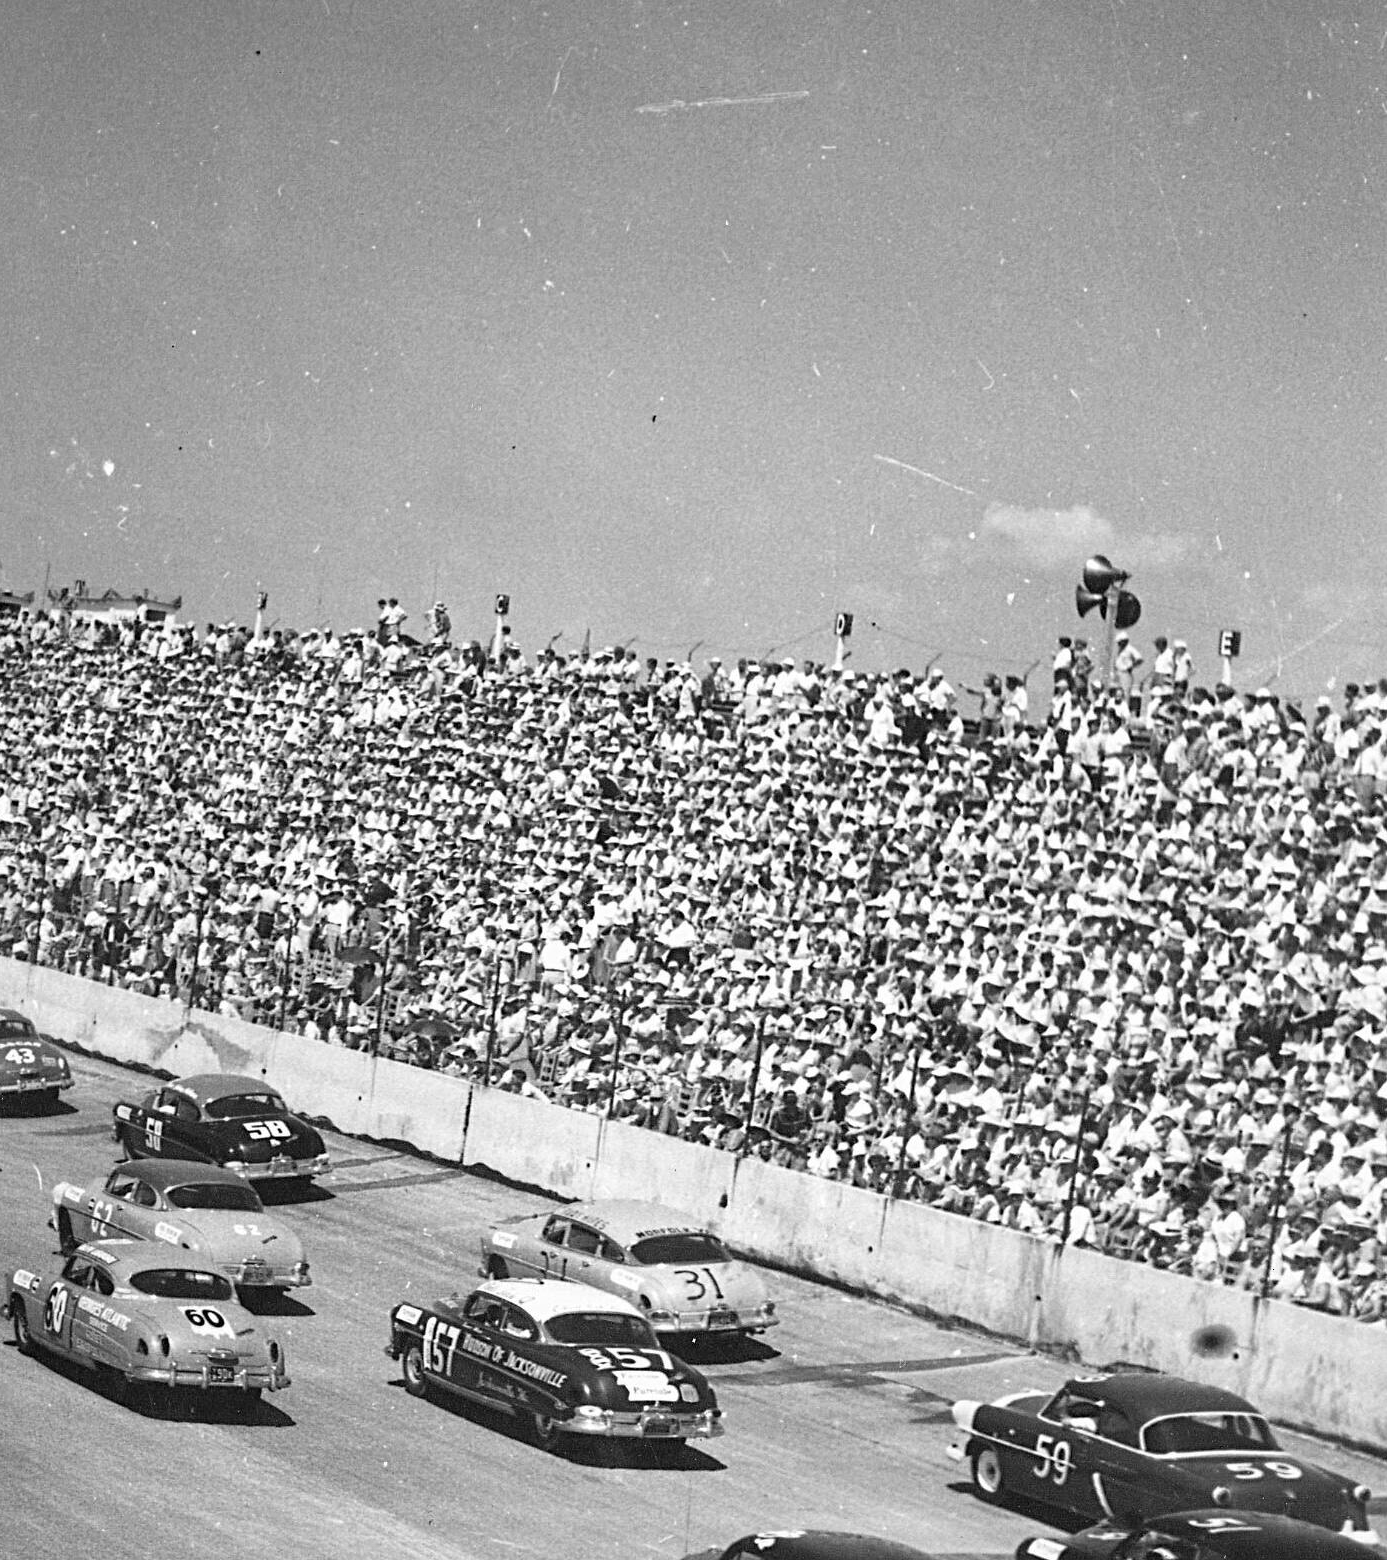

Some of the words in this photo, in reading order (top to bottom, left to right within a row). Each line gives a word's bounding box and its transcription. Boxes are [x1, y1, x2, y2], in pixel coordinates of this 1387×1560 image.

[1221, 631, 1233, 655] E
[4, 1048, 36, 1065] 43
[242, 1119, 291, 1140] 58
[90, 1200, 113, 1237] 62
[233, 1224, 262, 1236] 62
[674, 1268, 724, 1300] 31
[184, 1308, 225, 1328] 60
[503, 1350, 568, 1388] JACKSONVILLE
[1033, 1433, 1071, 1485] 59
[1225, 1462, 1303, 1480] 59
